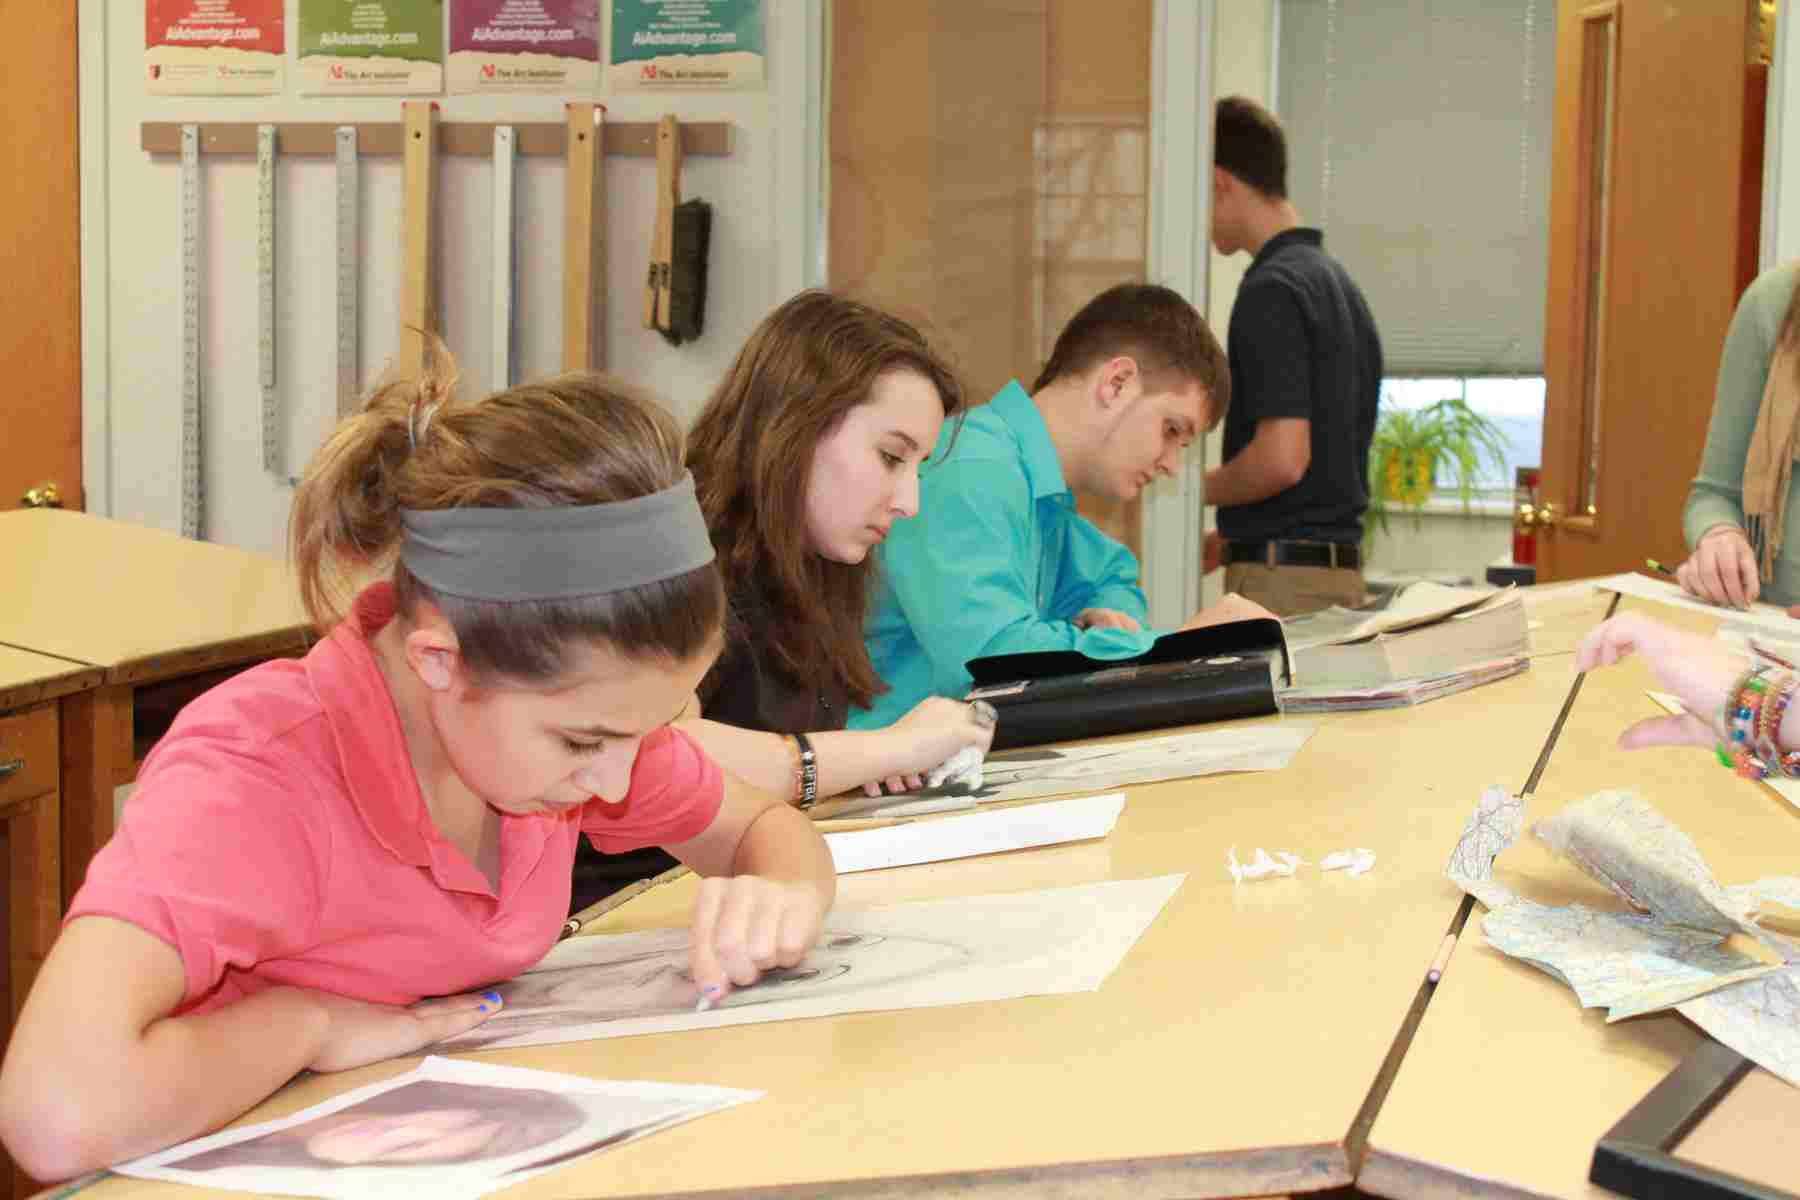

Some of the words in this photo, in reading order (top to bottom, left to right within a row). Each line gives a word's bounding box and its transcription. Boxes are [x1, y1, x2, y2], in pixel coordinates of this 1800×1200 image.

[166, 25, 261, 43] AiAdvantage.com
[320, 31, 418, 49] AiAdvantage.com
[472, 27, 574, 45] AiAdvantage.com
[632, 31, 737, 49] AiAdvantage.com
